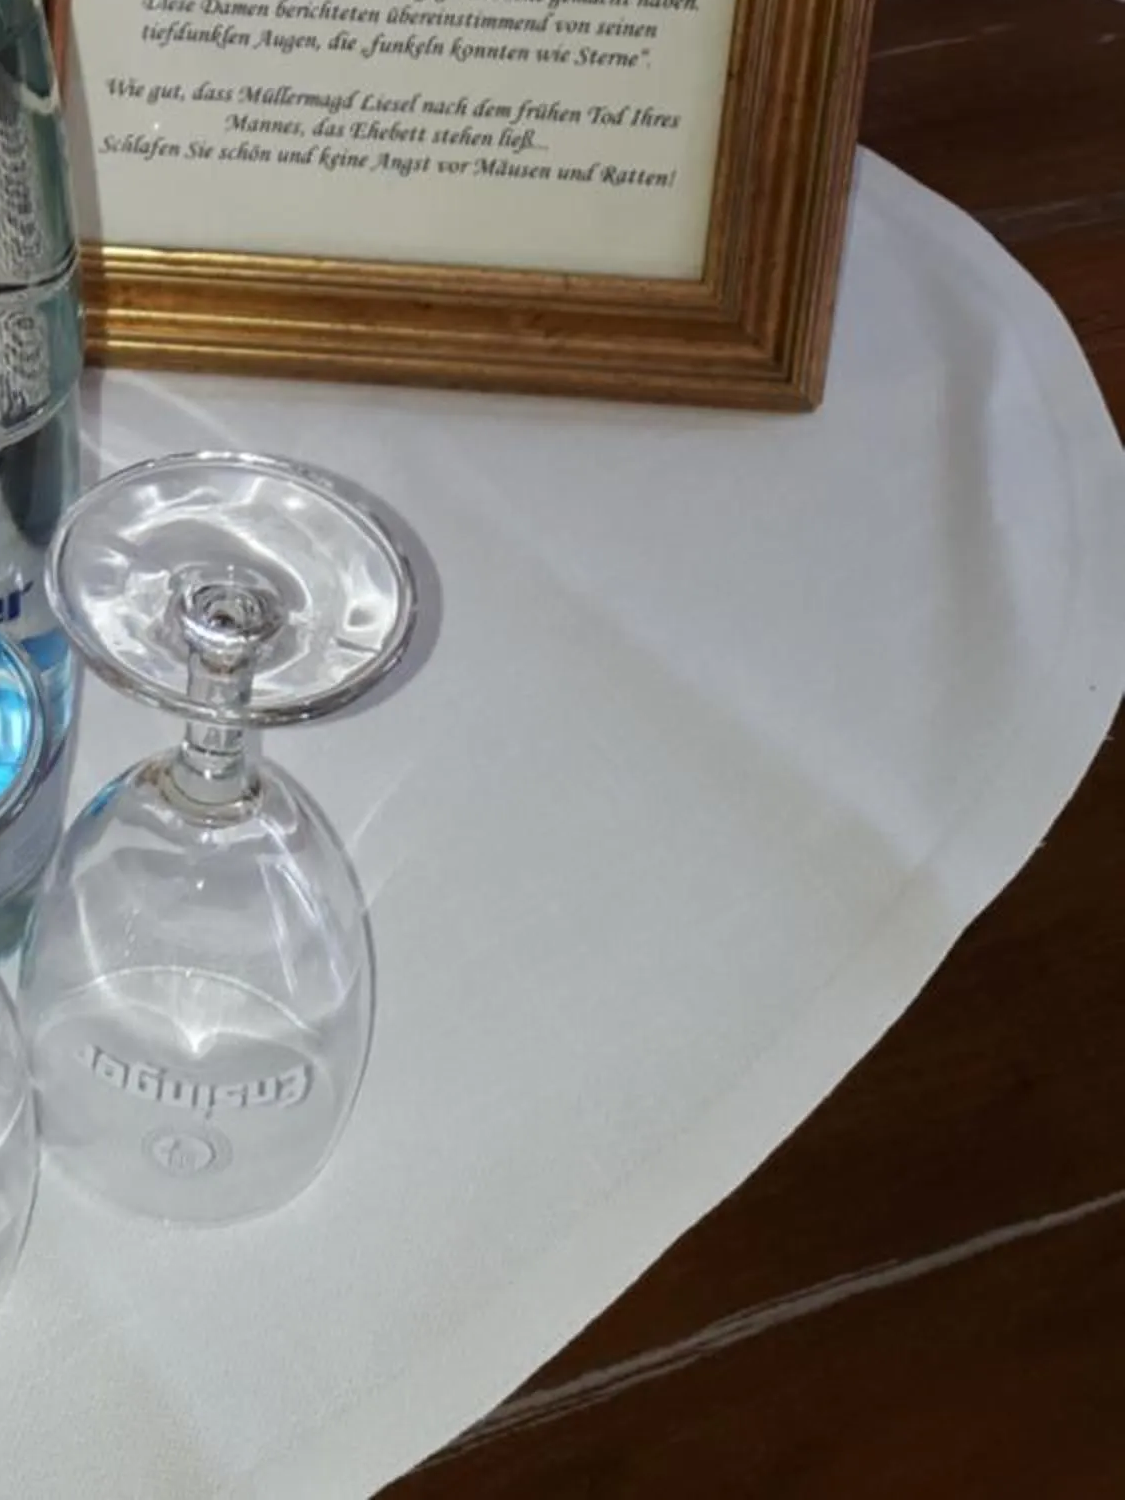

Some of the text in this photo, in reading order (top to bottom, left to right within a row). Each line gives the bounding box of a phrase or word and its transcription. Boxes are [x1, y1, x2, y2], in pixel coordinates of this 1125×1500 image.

[141, 21, 250, 49] tiefdunklen
[253, 30, 321, 53] Augen,
[327, 30, 357, 51] die
[450, 37, 529, 62] konnten
[536, 44, 571, 64] wie
[106, 77, 682, 128] Wie gut, dass Müllermagd Liesel nach dem frühen Tod Ihres
[99, 134, 677, 188] Schlafen Sie schön und keine Angst vor Mäusen und Ratten!
[74, 1043, 314, 1121] Ensinger
